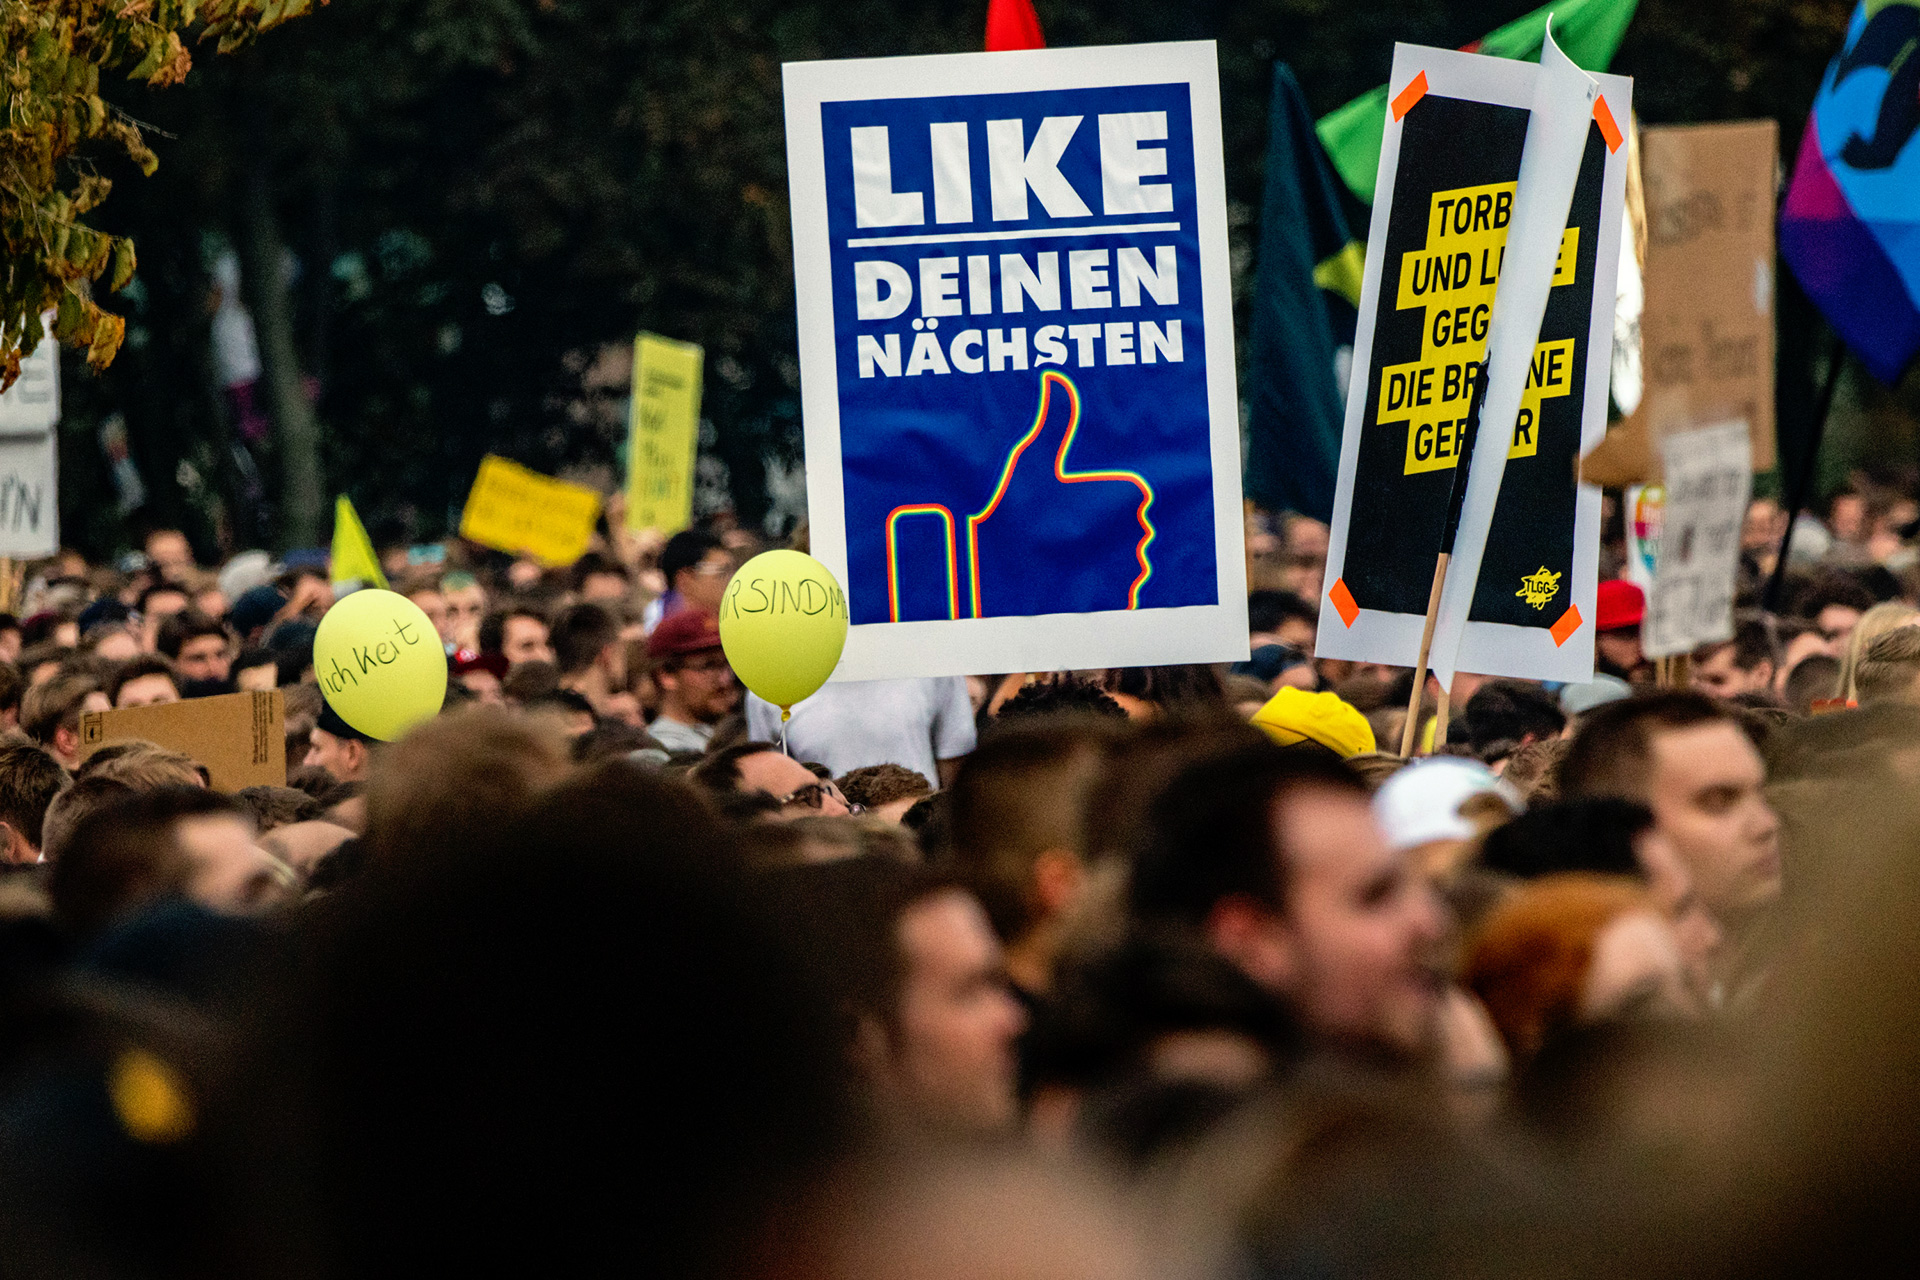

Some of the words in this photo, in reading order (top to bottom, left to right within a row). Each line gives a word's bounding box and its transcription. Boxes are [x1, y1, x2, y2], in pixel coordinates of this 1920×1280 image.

[850, 110, 1174, 229] LIKE
[1437, 190, 1513, 238] TORB
[854, 245, 1179, 321] DEINEN
[1412, 251, 1472, 296] UND
[857, 317, 1184, 379] NÄCHSTEN
[1432, 303, 1490, 348] GEG
[1387, 367, 1435, 412] DIE
[1441, 347, 1566, 403] BRNE
[1414, 407, 1534, 462] GEFR
[1525, 580, 1550, 595] TLGG
